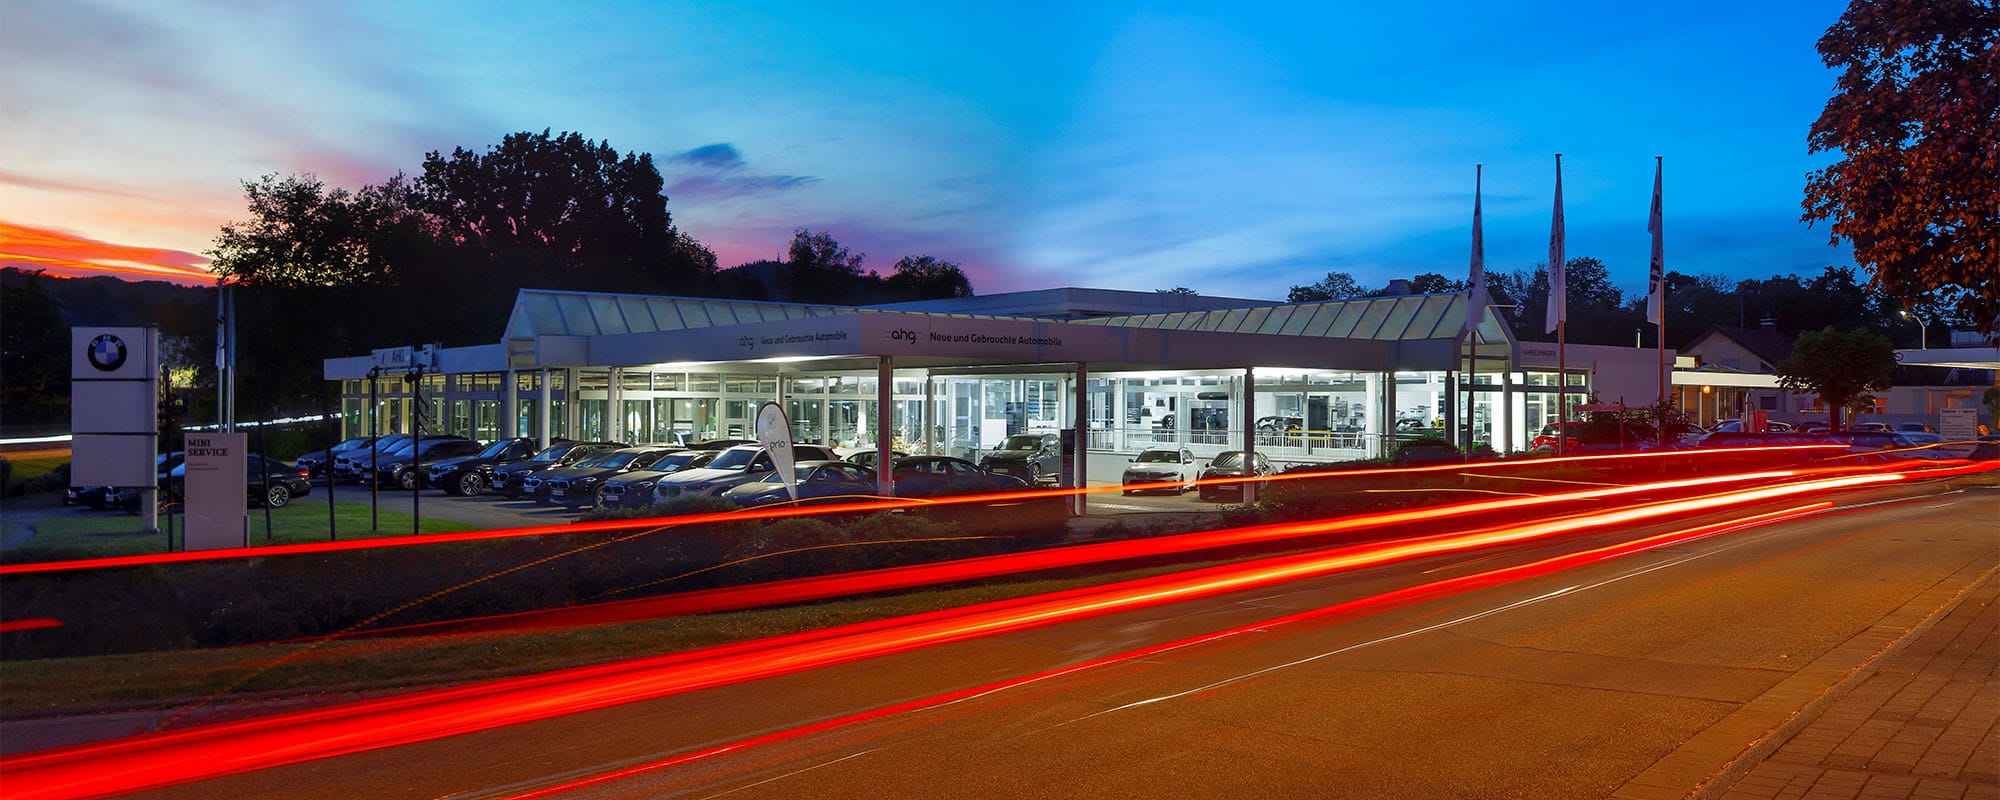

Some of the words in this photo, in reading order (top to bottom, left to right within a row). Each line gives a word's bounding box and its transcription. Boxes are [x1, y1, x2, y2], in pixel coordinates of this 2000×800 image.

[740, 335, 754, 350] ahg
[761, 336, 773, 345] Neue
[774, 335, 785, 345] und
[785, 334, 814, 344] Gebrauchte
[816, 331, 847, 342] Automobile
[891, 328, 916, 345] ahg
[930, 332, 952, 342] Neue
[953, 334, 969, 343] und
[970, 333, 1017, 345] Gebrauchte
[1018, 335, 1063, 346] Automobile
[187, 439, 211, 447] MINI
[187, 448, 228, 457] SERVICE
